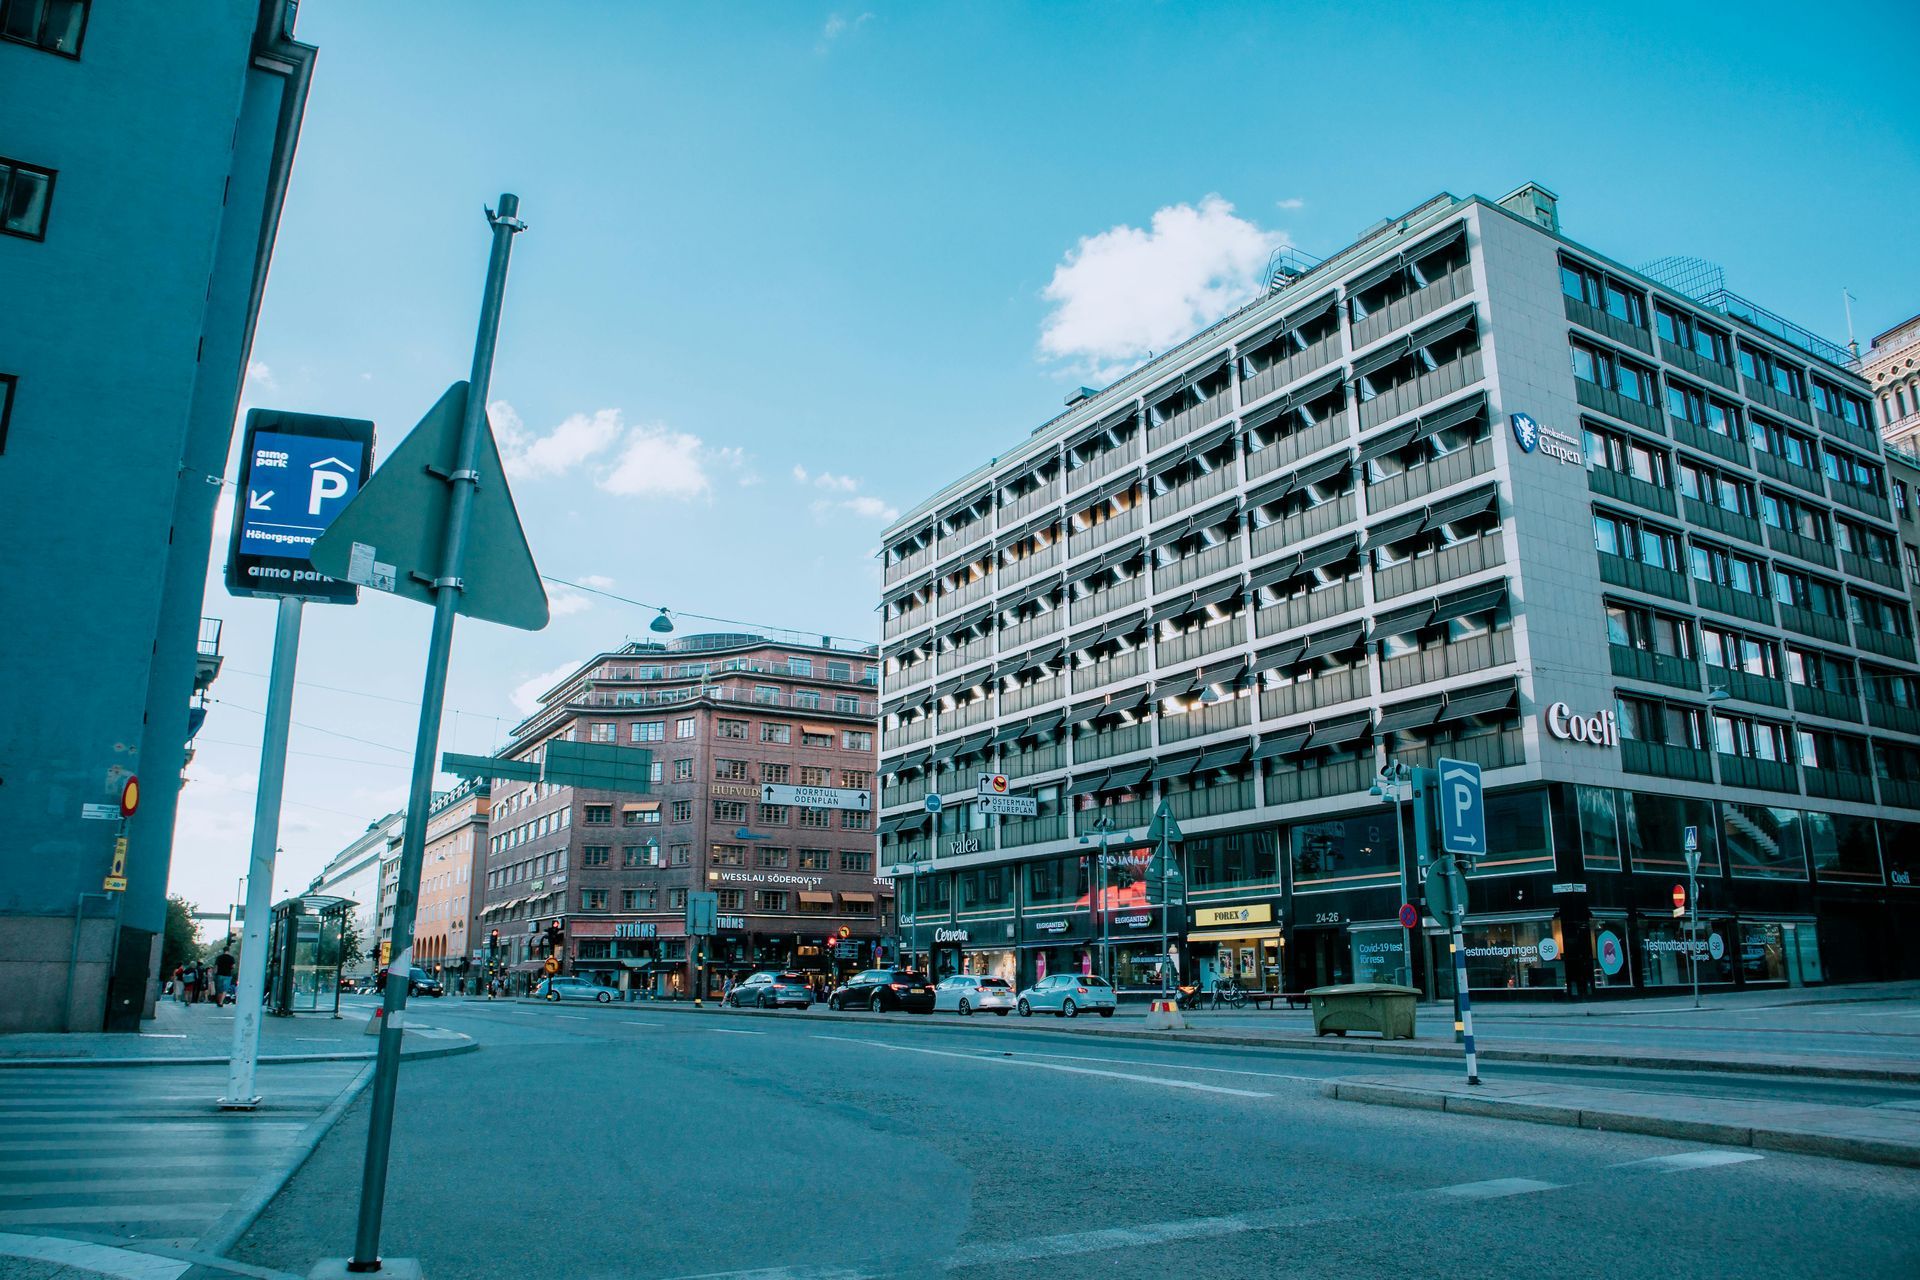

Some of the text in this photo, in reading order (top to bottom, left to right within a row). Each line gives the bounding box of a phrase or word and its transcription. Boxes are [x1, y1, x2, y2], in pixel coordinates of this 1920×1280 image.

[256, 449, 289, 460] aimo
[1539, 435, 1582, 465] Gripen
[255, 457, 288, 468] park
[308, 469, 349, 516] P
[247, 566, 291, 579] aimo
[1547, 702, 1618, 747] Coeli
[795, 787, 838, 798] NORRTULL
[794, 796, 839, 805] ODENPLAN
[992, 797, 1035, 807] ÖSTERMALM
[1454, 783, 1472, 827] P
[992, 805, 1033, 814] STUREPLAN
[950, 832, 979, 855] valea
[721, 872, 765, 882] WESSLAU
[900, 914, 914, 924] Coel
[1114, 915, 1148, 924] ELGIGANTEN
[1214, 910, 1240, 921] FOREX
[1315, 912, 1339, 923] 24-26
[716, 915, 745, 929] TRÖMS
[1036, 921, 1065, 930] ELGIGANTEN
[614, 920, 656, 938] STRÖMS
[934, 927, 969, 943] Cervera
[1359, 942, 1404, 953] Covid-19 test
[1644, 938, 1709, 954] Testmottagnigen
